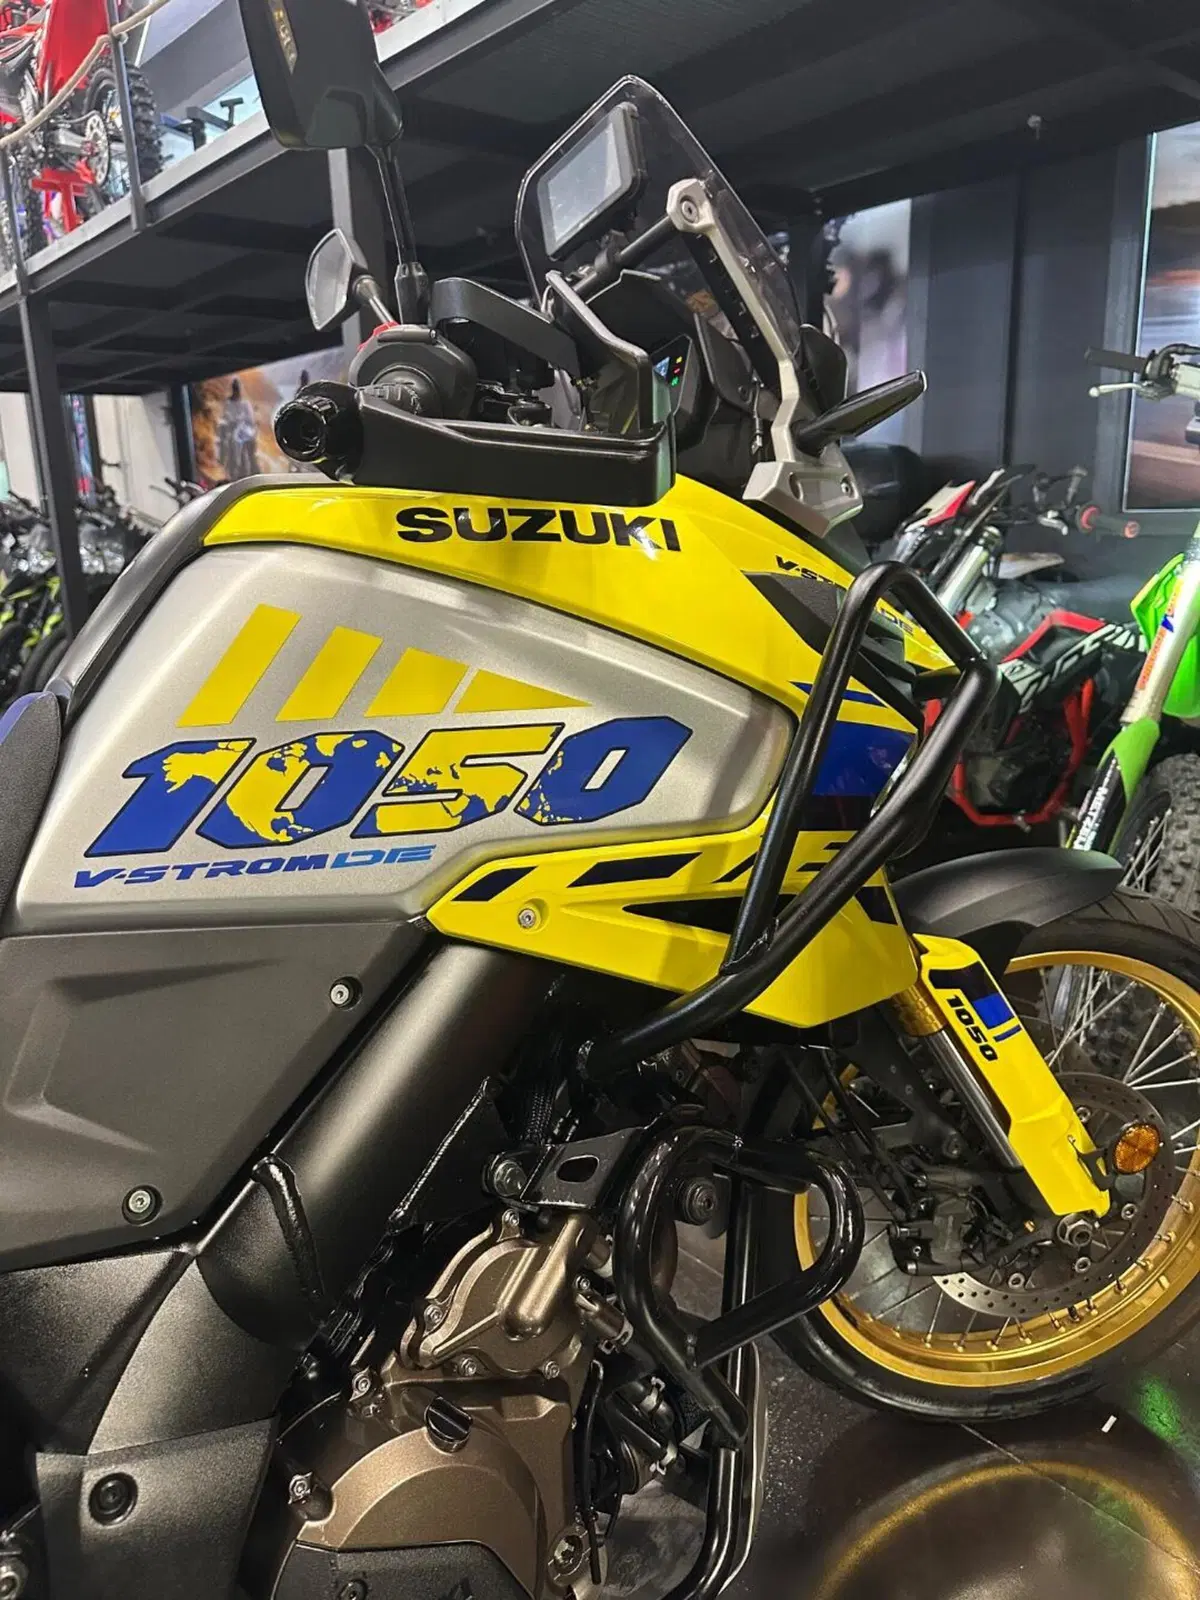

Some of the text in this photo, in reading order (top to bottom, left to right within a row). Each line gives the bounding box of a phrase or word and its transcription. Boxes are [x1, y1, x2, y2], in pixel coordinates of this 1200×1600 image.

[396, 506, 682, 552] SUZUKI
[84, 716, 693, 858] 1050
[946, 994, 999, 1062] 1050
